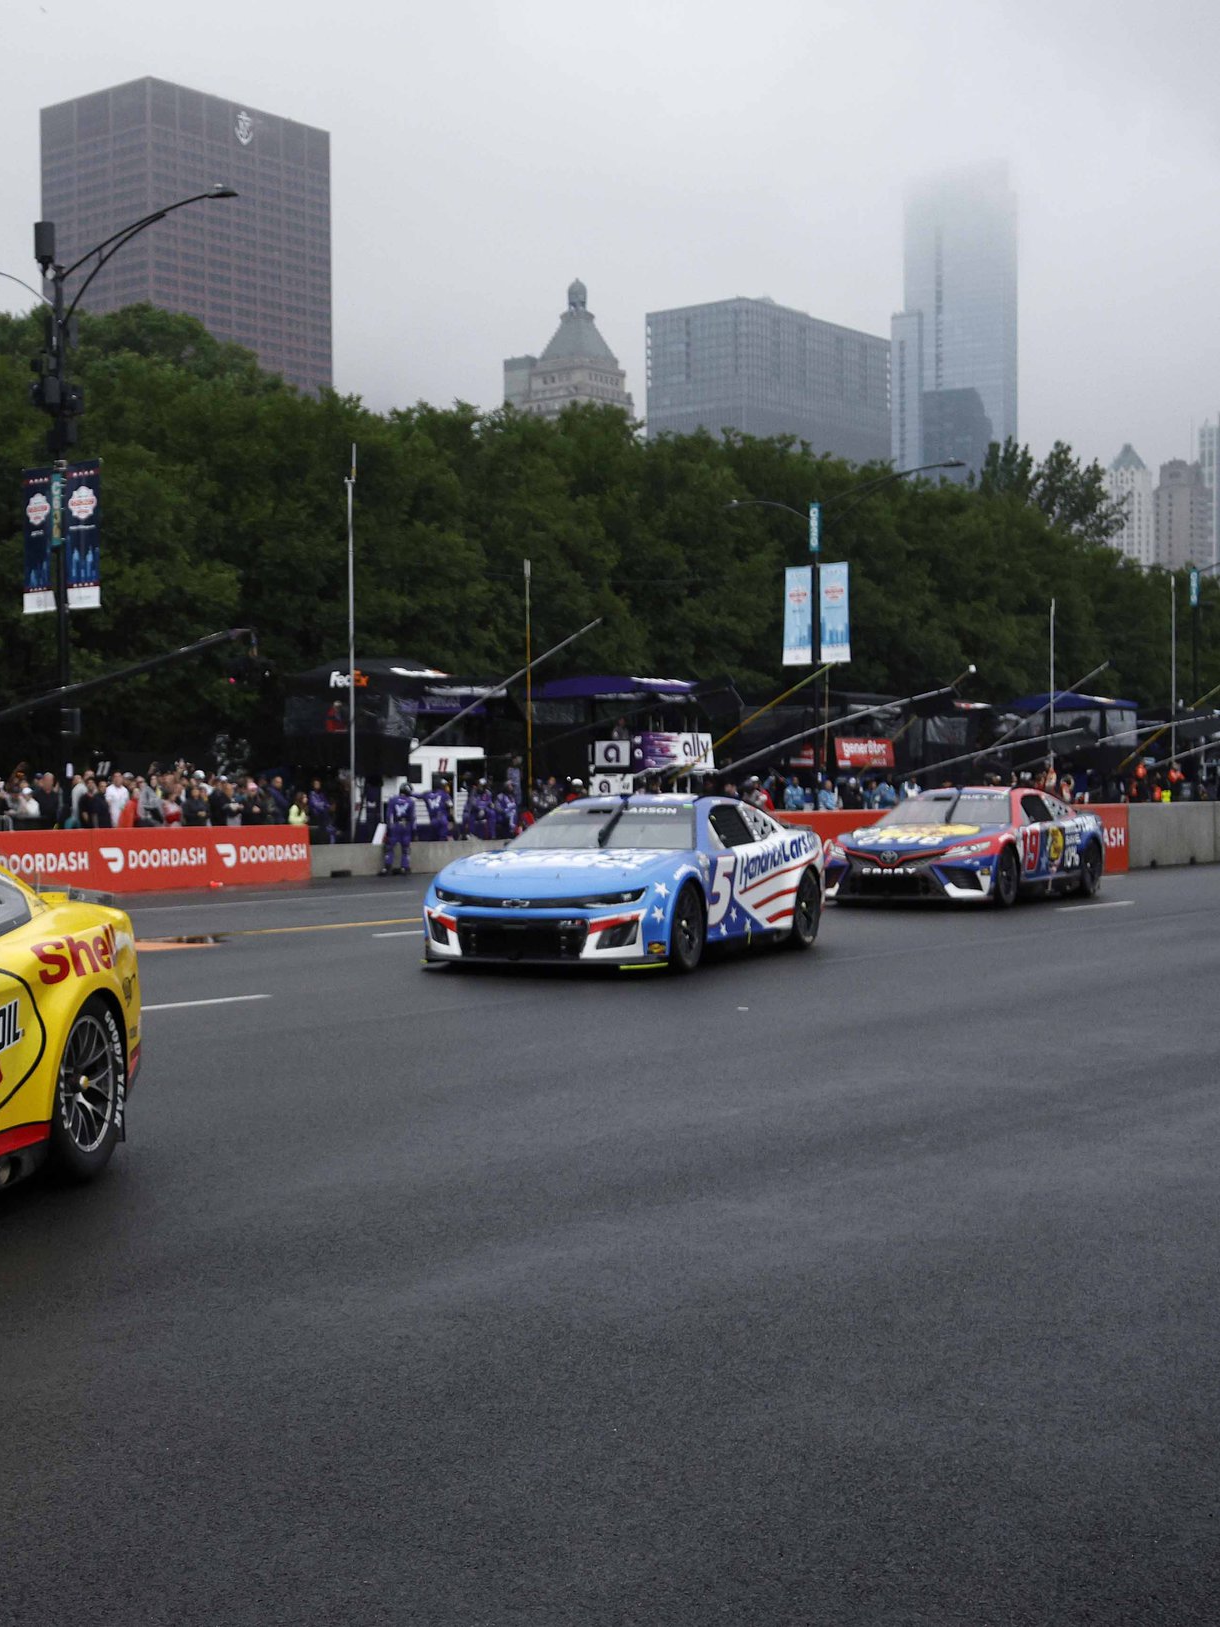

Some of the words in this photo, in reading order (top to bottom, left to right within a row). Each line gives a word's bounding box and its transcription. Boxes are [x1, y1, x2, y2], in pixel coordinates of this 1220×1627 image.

[683, 733, 708, 763] ally
[129, 847, 207, 868] DOORDASH
[240, 843, 308, 863] DOORDASH
[709, 854, 735, 927] 5
